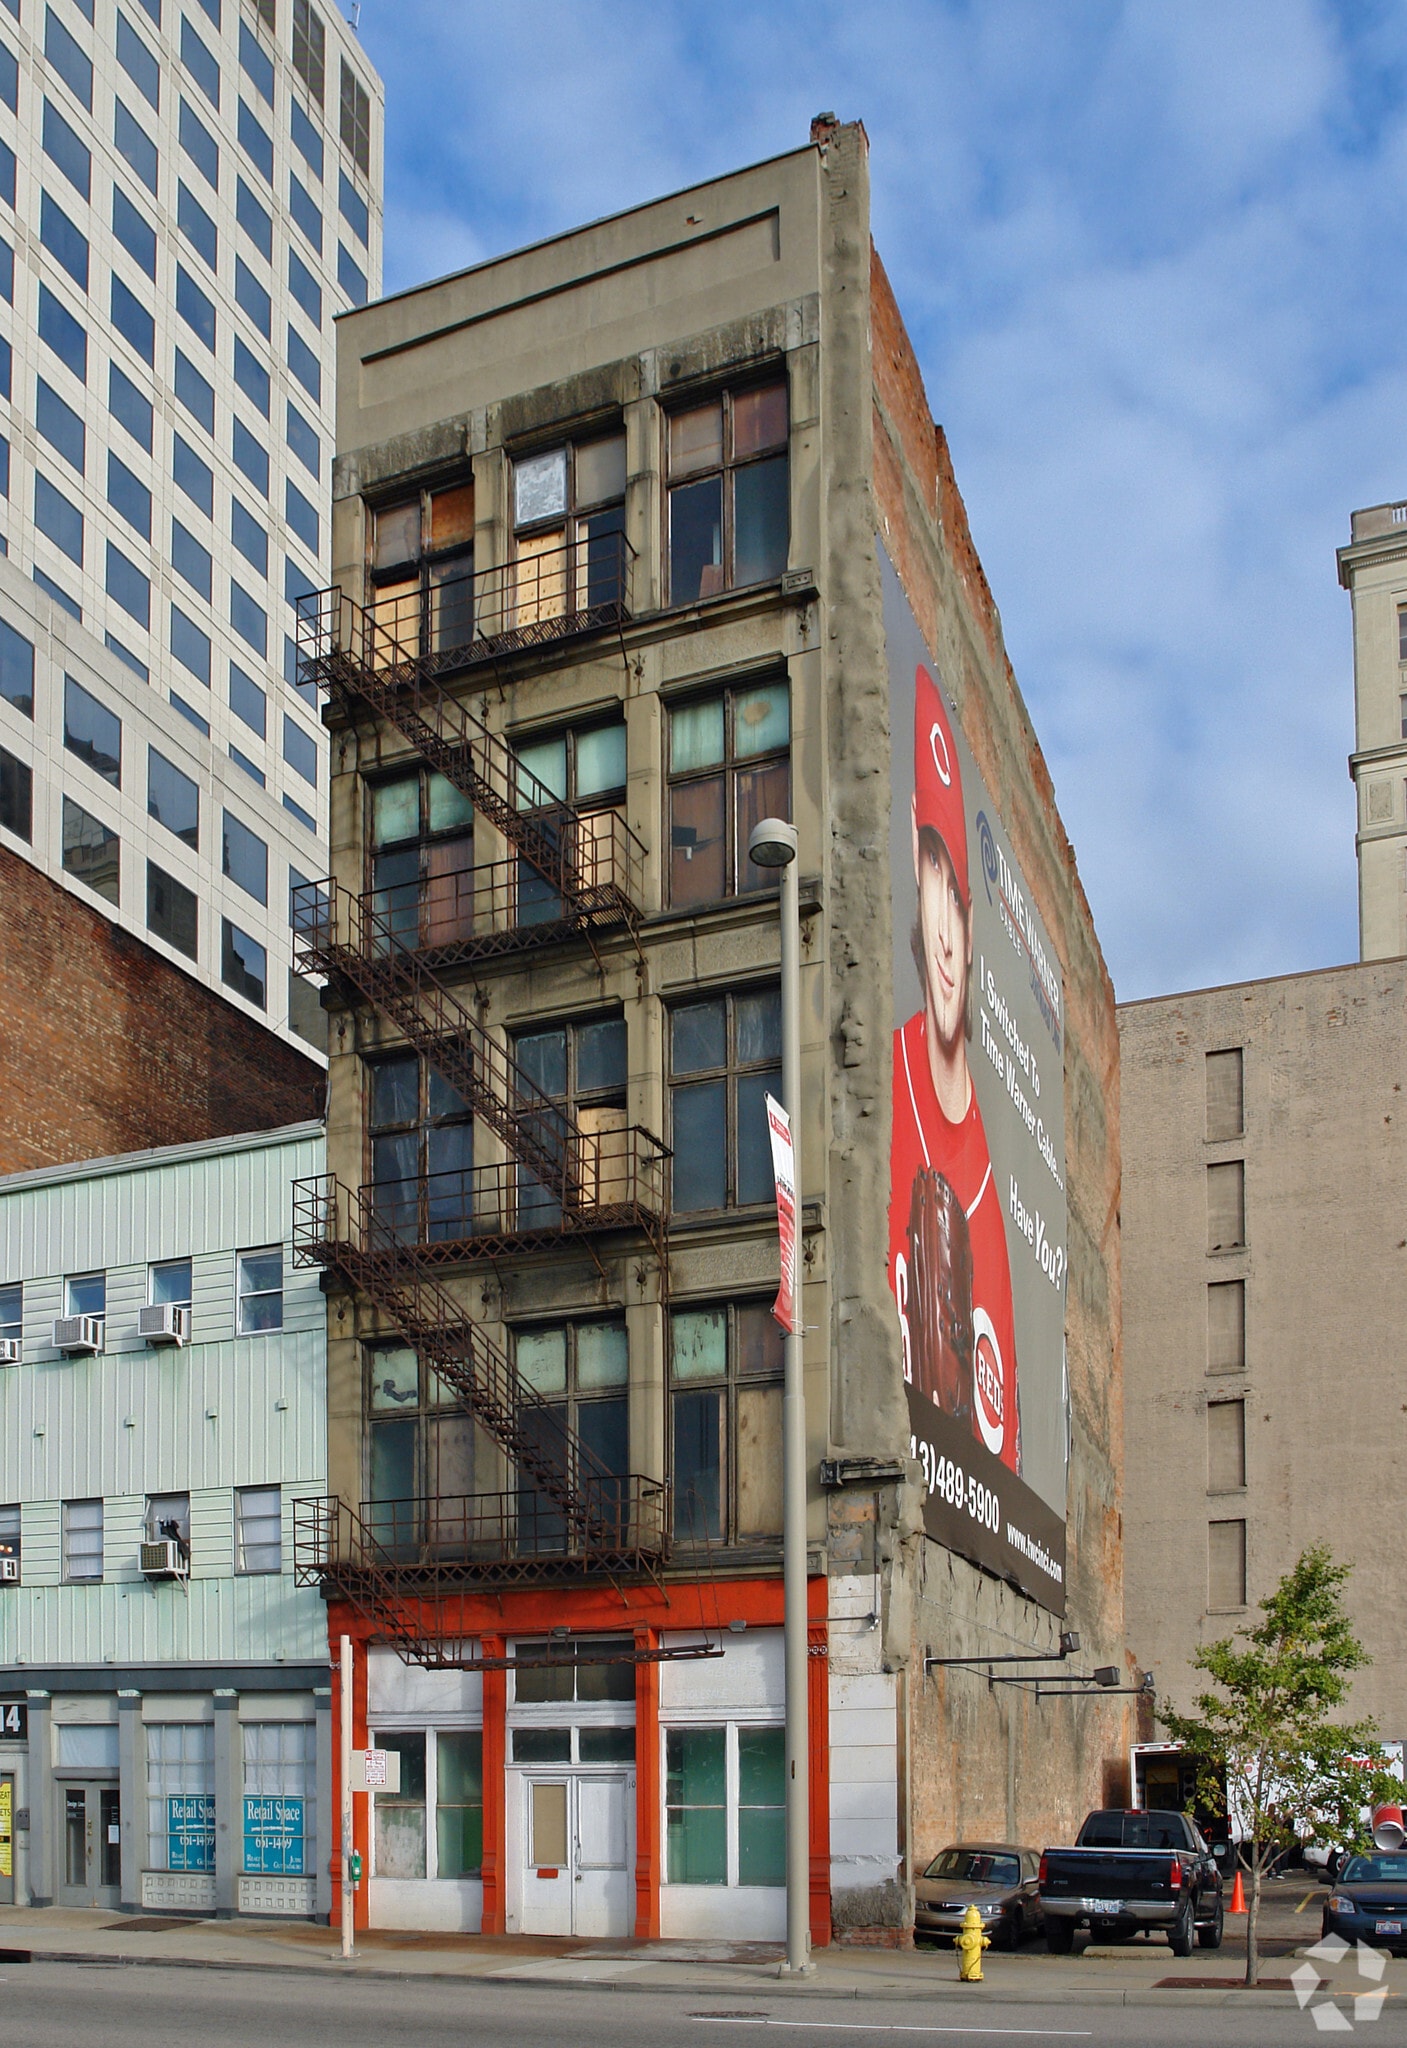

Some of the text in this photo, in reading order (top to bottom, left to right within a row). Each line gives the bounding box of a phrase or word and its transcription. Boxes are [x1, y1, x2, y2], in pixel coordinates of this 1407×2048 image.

[996, 844, 1025, 933] TIME
[1024, 905, 1060, 1020] WARNER
[999, 901, 1021, 957] CABLE
[980, 954, 1040, 1097] I Switched To
[980, 1006, 1064, 1191] Time Warner Cable...
[1009, 1173, 1064, 1291] Have You?
[1007, 1522, 1062, 1583] www.twcinci.com
[172, 1800, 216, 1823] Reail Sac
[247, 1801, 300, 1825] Retail Space
